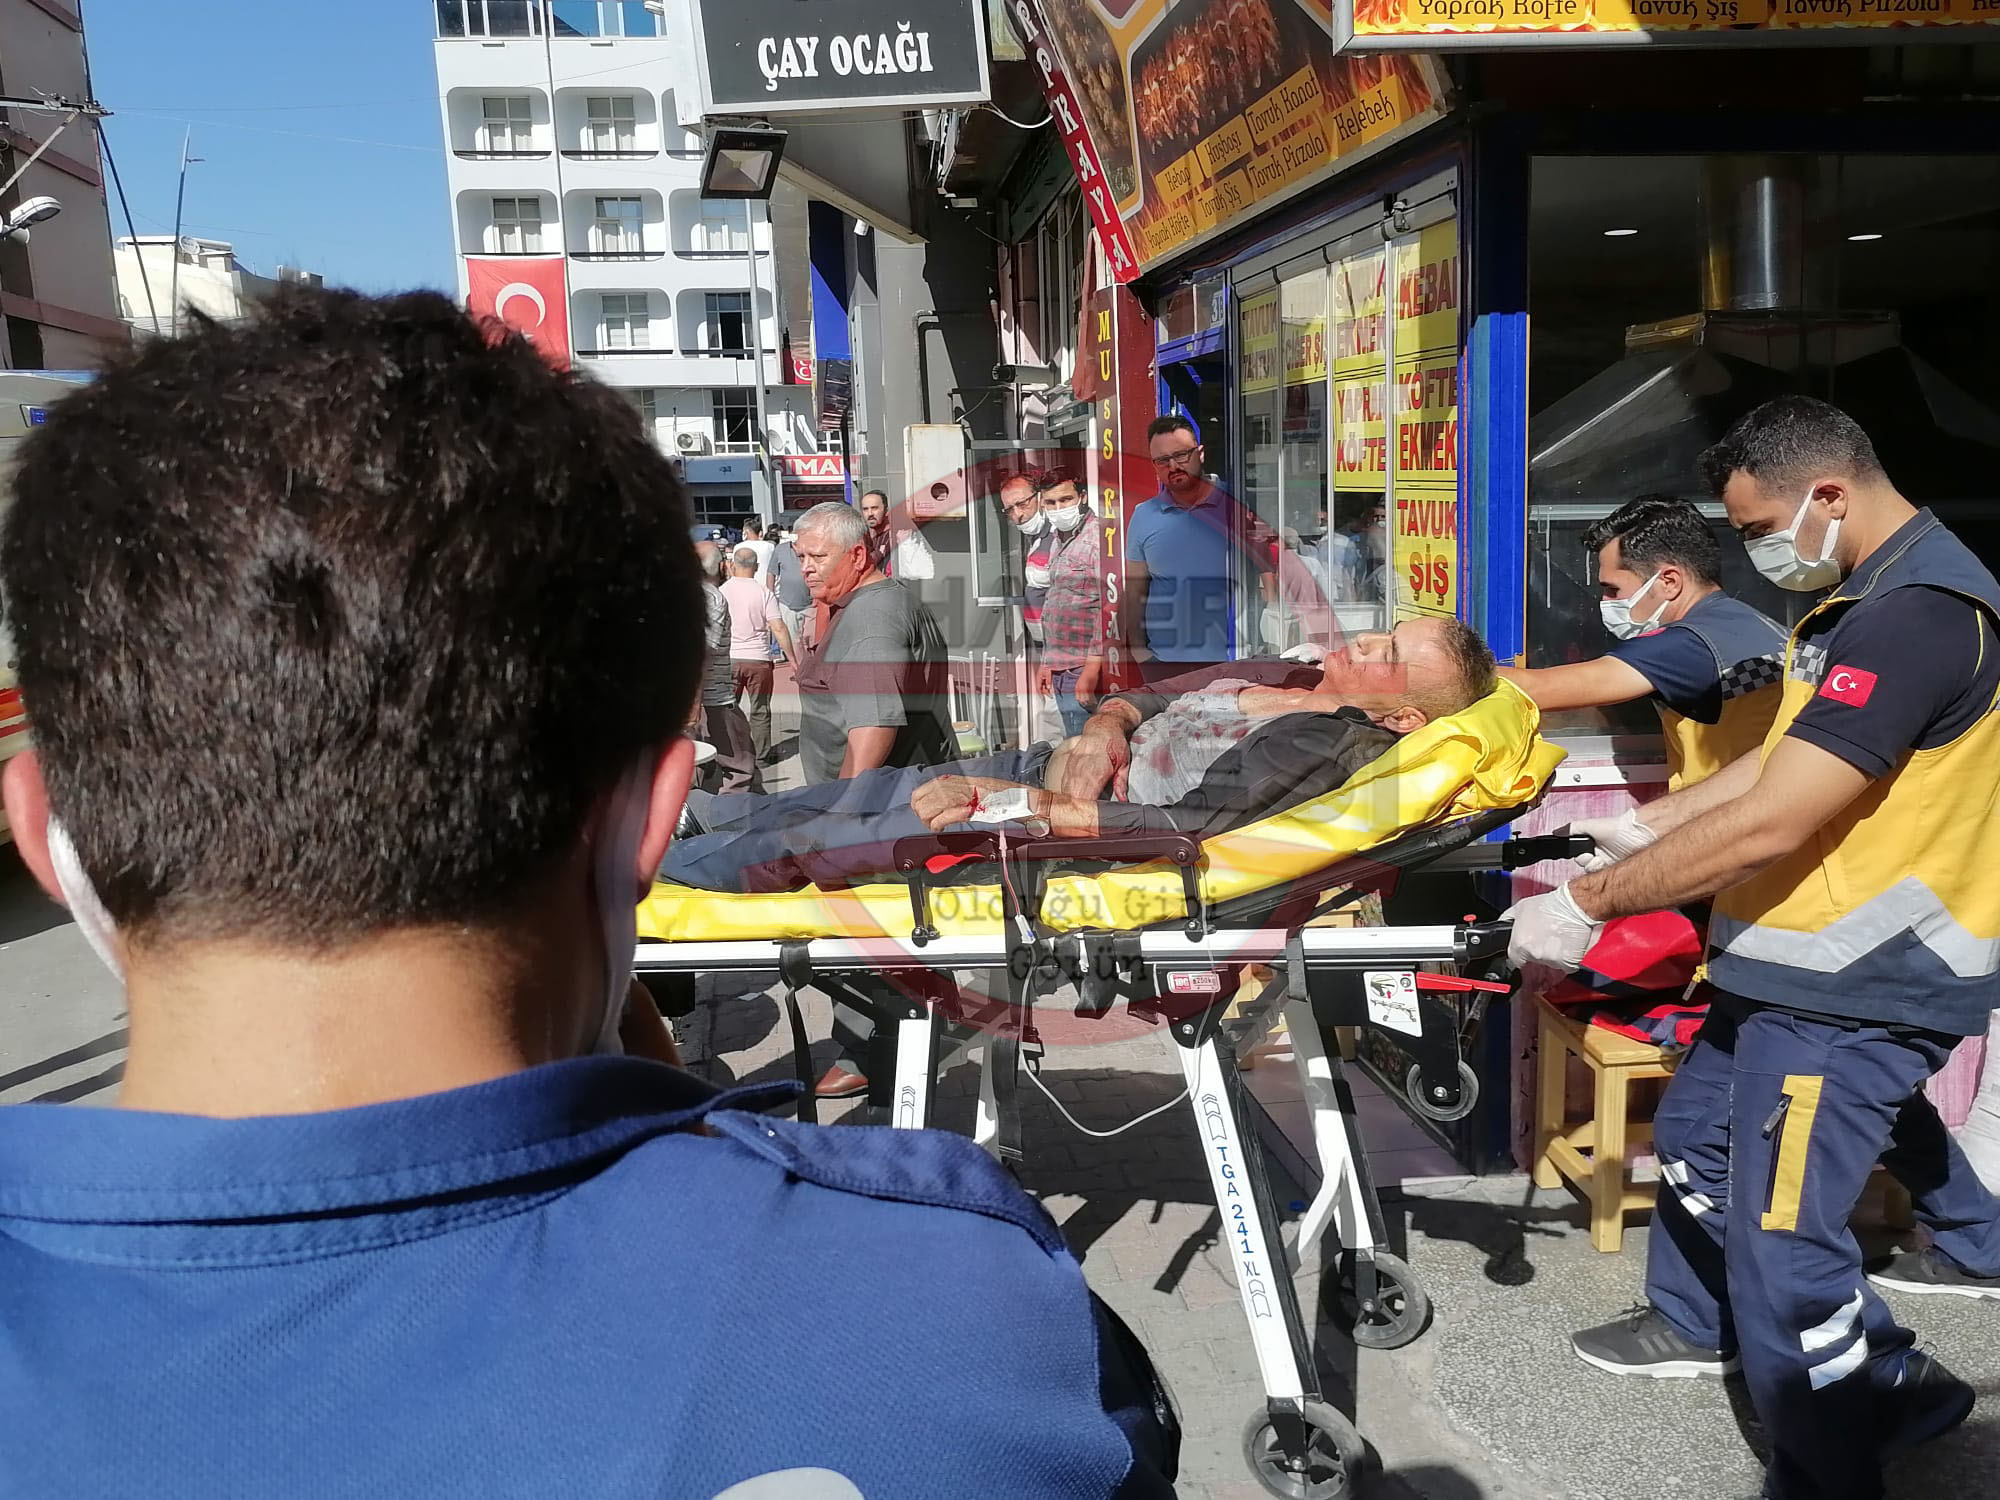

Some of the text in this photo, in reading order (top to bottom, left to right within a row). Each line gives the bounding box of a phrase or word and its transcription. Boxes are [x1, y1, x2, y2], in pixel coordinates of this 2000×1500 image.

[758, 20, 934, 91] ÇAY OCAĞI
[1247, 70, 1320, 135] Tavuk Kanat
[1333, 89, 1396, 142] Kelebek
[1204, 131, 1242, 165] Kuşbaşı
[1249, 132, 1325, 189] Tavuk Pirzola
[1399, 362, 1457, 411] KÖFTE
[1336, 431, 1386, 473] KÖFTE
[1399, 420, 1457, 471] EKMEK
[1397, 499, 1457, 541] TAVUK
[1409, 543, 1449, 606] ŞİŞ
[1216, 1146, 1261, 1277] TGA 241 XL
